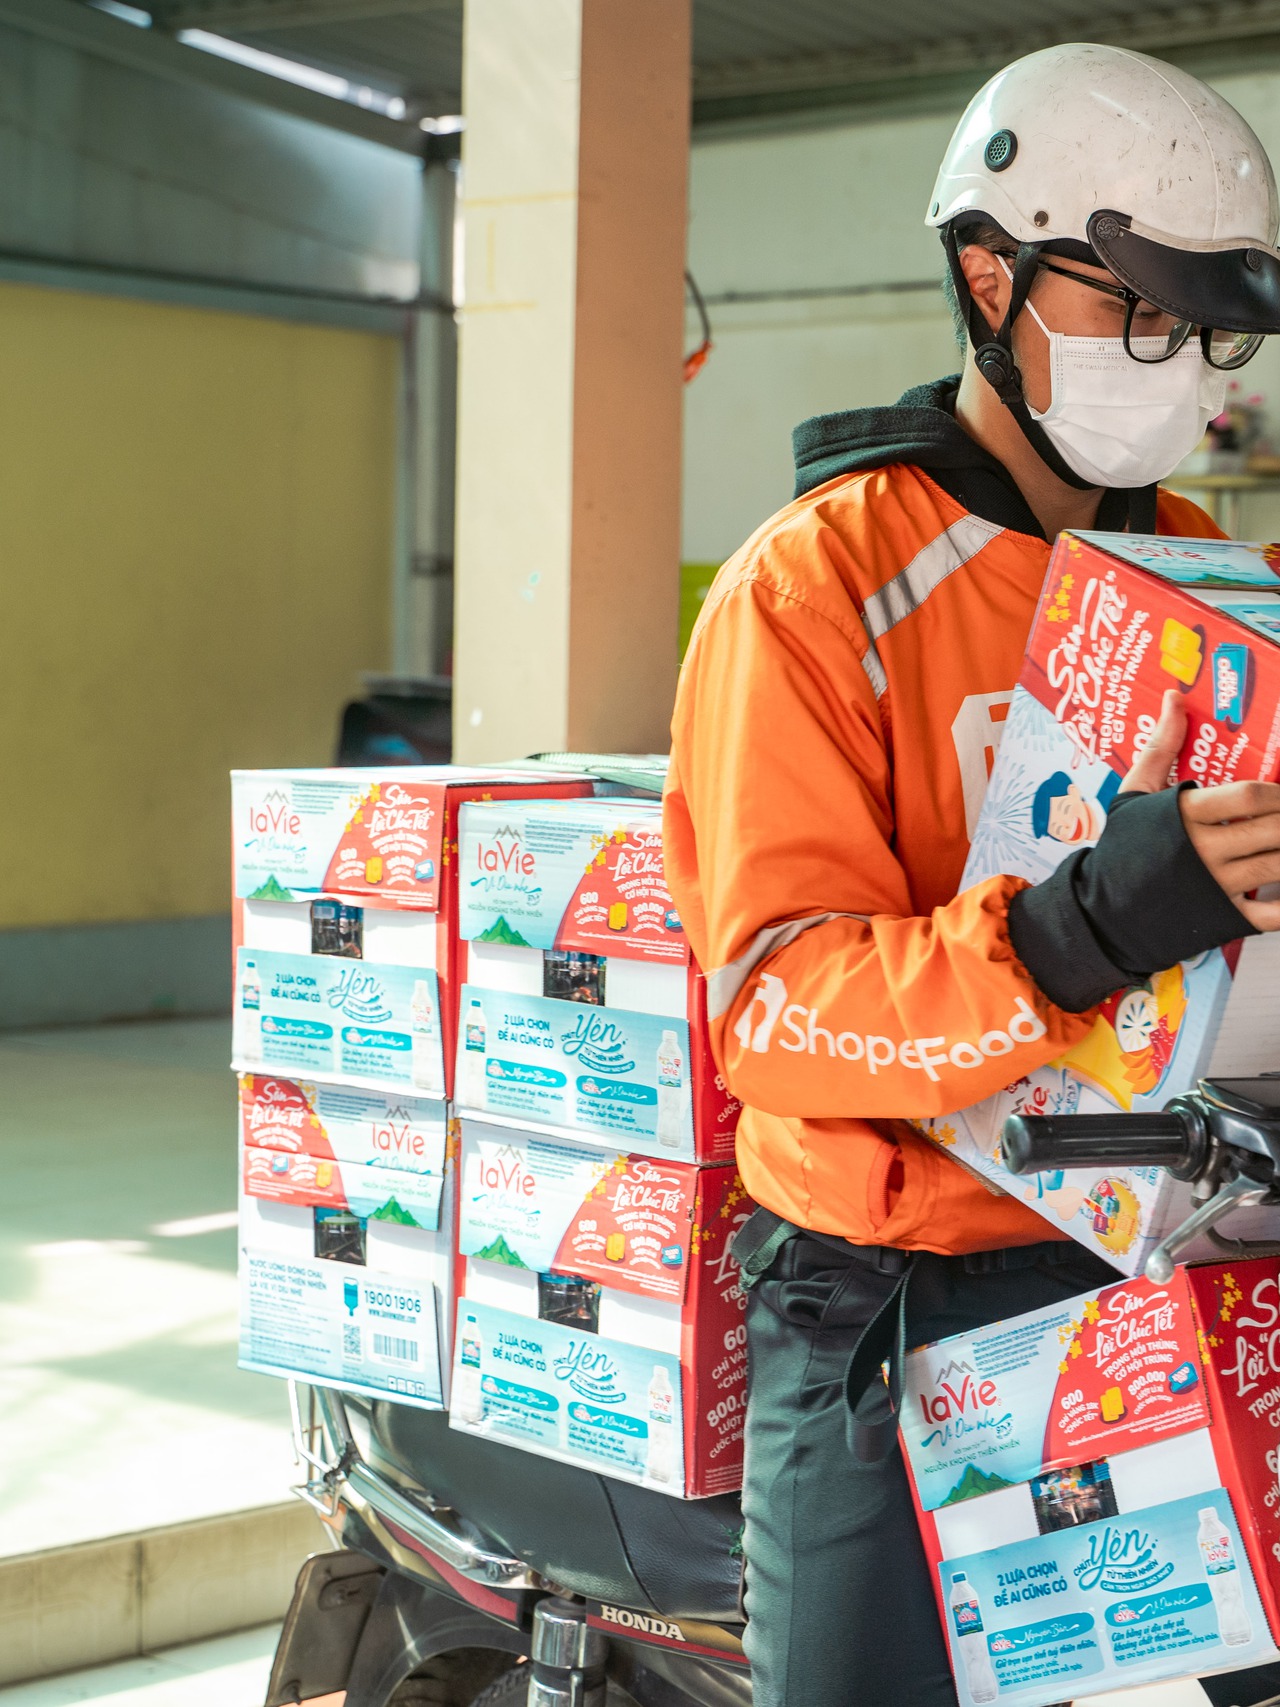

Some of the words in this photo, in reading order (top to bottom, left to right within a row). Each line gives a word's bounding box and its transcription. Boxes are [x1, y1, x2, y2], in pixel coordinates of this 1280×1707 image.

[1117, 685, 1133, 716] HỘI
[1100, 700, 1116, 760] TRONG
[249, 804, 301, 835] laVie
[477, 840, 536, 876] laVie
[276, 973, 281, 984] 2
[282, 989, 290, 999] AI
[328, 968, 382, 1009] Yên
[504, 1014, 509, 1024] 2
[510, 1014, 524, 1028] LỰA
[527, 1016, 550, 1031] CHỌN
[562, 1013, 622, 1056] Yên
[498, 1028, 509, 1041] ĐỂ
[511, 1031, 518, 1042] AI
[519, 1030, 541, 1047] CŨNG
[543, 1033, 555, 1049] CÓ
[778, 996, 1048, 1082] ShopeFood
[372, 1121, 426, 1156] laVie
[479, 1158, 537, 1197] laVie
[364, 1290, 393, 1308] 1900
[394, 1295, 422, 1314] 1906
[1097, 1291, 1169, 1328] Săn
[499, 1332, 504, 1343] 2
[504, 1333, 519, 1348] LỰA
[521, 1337, 543, 1355] CHỌN
[723, 1323, 748, 1352] 60
[1087, 1331, 1117, 1369] Lời
[492, 1346, 503, 1360] ĐỂ
[504, 1350, 512, 1362] AI
[513, 1353, 534, 1370] CŨNG
[535, 1359, 547, 1373] CÓ
[554, 1340, 614, 1381] Yên
[711, 1355, 730, 1381] CHỈ
[1102, 1353, 1131, 1379] TRONG
[1130, 1341, 1147, 1359] MỖI
[1114, 1367, 1128, 1382] CƠ
[1127, 1359, 1143, 1374] HỘI
[1143, 1351, 1174, 1366] TRÚNG
[1220, 1336, 1269, 1398] Lời
[1127, 1370, 1167, 1396] 800.000
[920, 1374, 998, 1425] laVie
[1060, 1389, 1084, 1411] 600
[708, 1436, 732, 1460] CƯỚC
[998, 1574, 1005, 1587] 2
[1005, 1568, 1027, 1585] LỰA
[1028, 1560, 1059, 1580] CHỌN
[1073, 1558, 1091, 1577] CHÚT
[1079, 1527, 1150, 1592] Yên
[1106, 1569, 1117, 1580] TỪ
[1116, 1566, 1139, 1580] THIÊN
[1138, 1559, 1160, 1577] NHIÊN
[993, 1588, 1009, 1608] ĐỂ
[1010, 1591, 1022, 1605] AI
[1023, 1581, 1052, 1602] CŨNG
[1051, 1575, 1069, 1593] CÓ
[600, 1604, 687, 1642] HONDA
